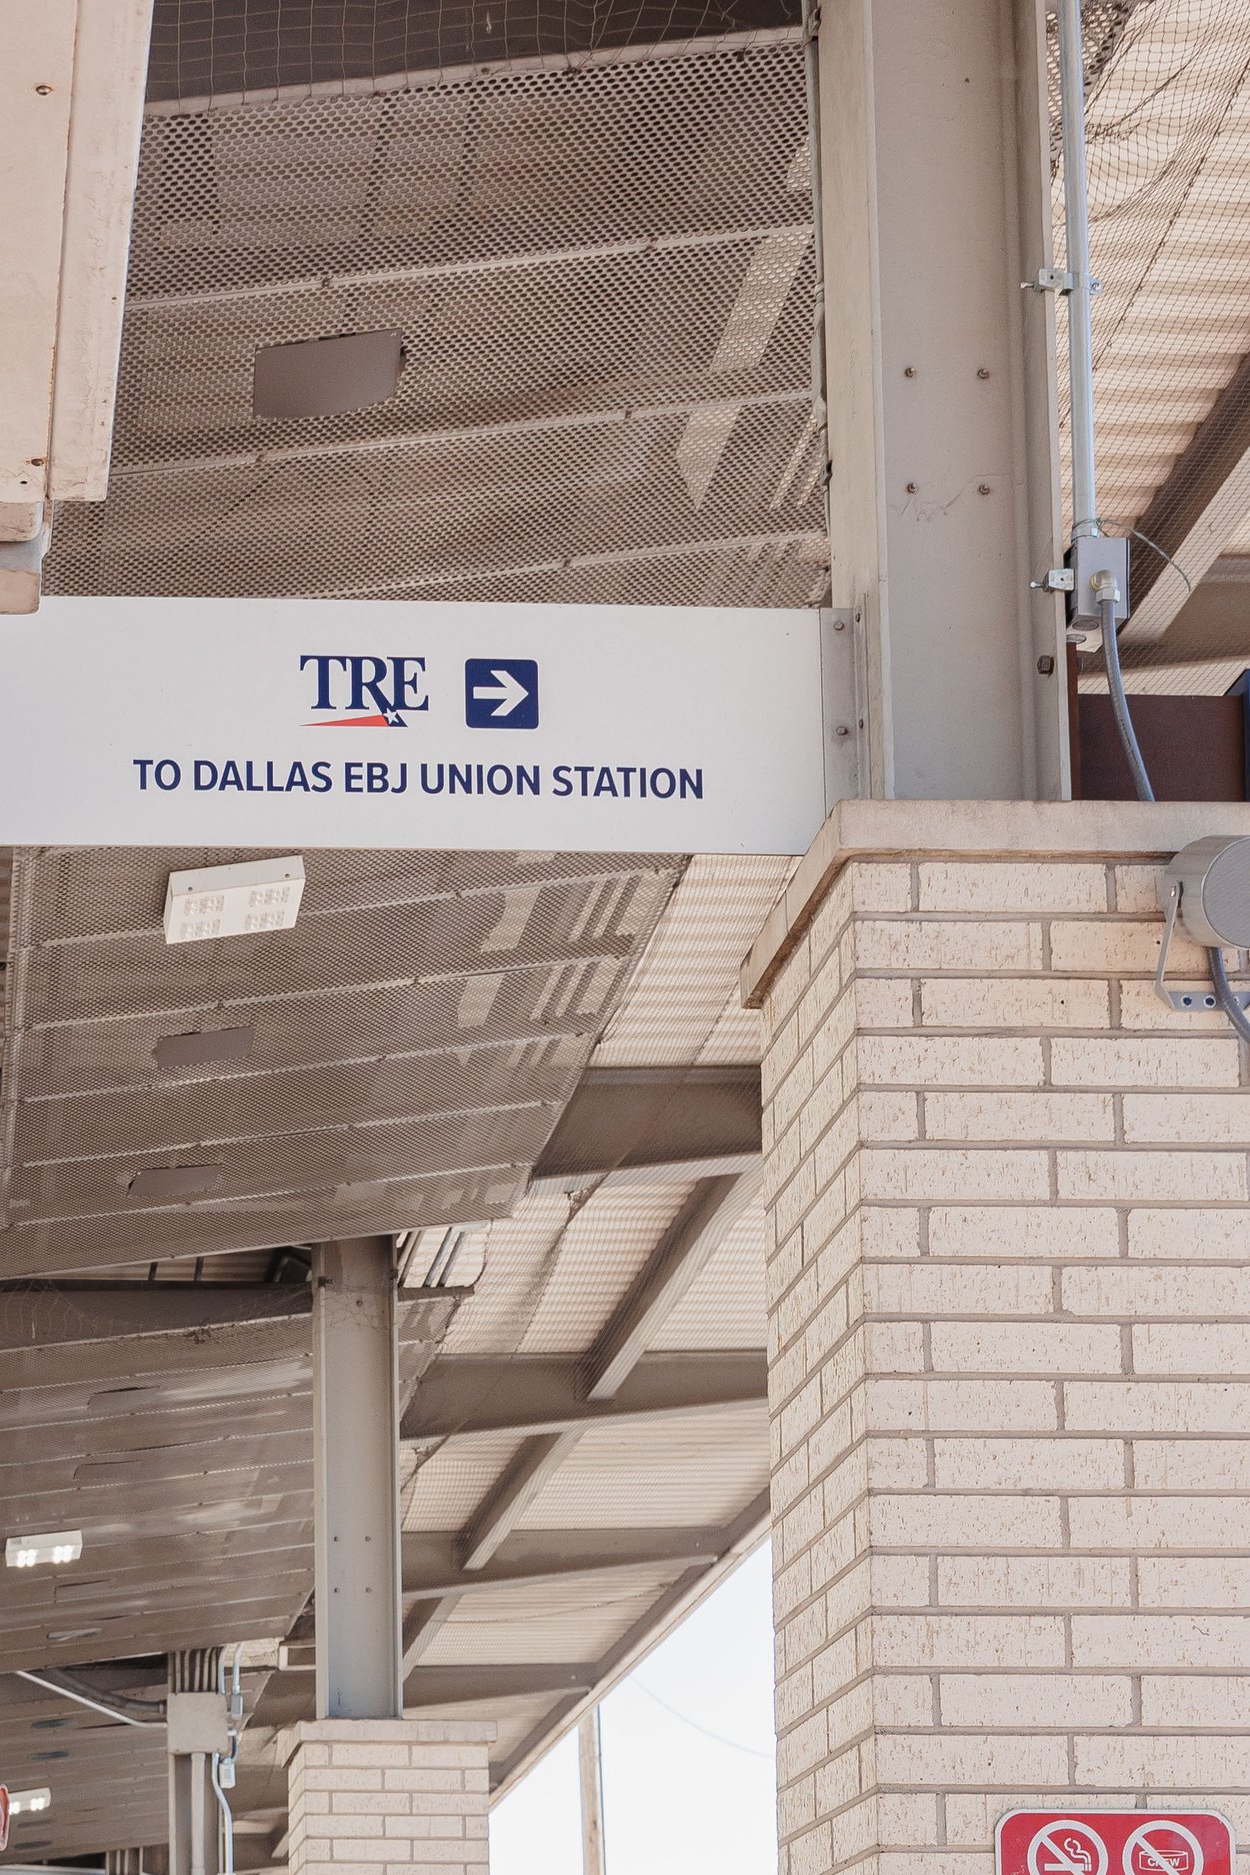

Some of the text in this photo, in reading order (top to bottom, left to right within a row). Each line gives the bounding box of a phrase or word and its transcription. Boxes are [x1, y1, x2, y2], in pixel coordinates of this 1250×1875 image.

[299, 655, 430, 728] TRE
[132, 759, 704, 800] TO DALLAS EBJ UNION STATION
[1147, 1857, 1181, 1867] CW
